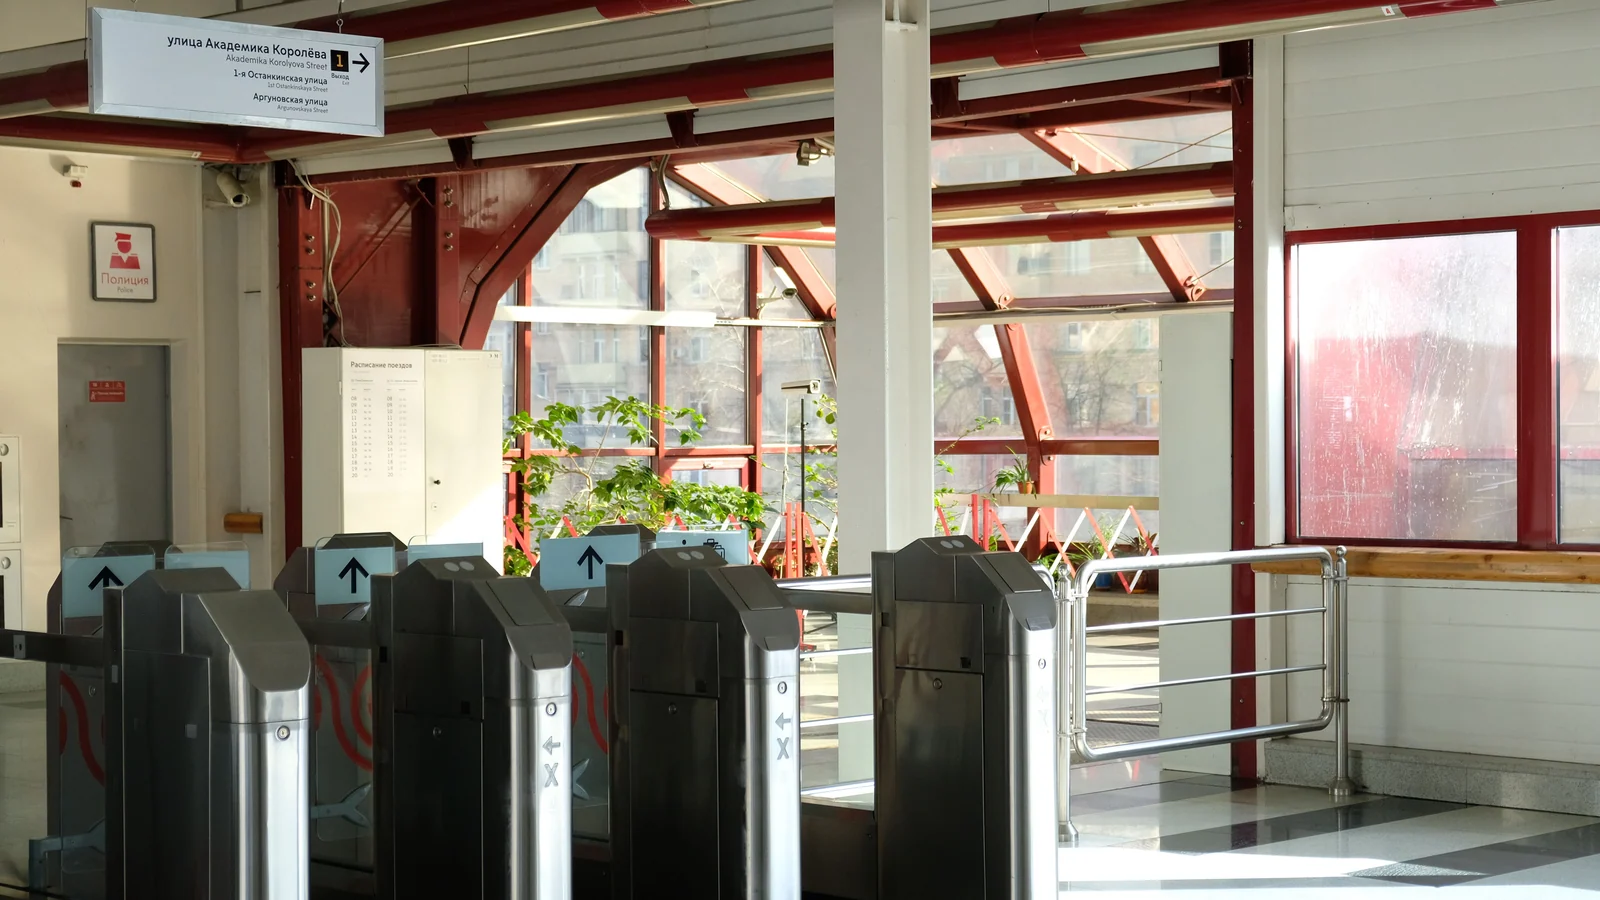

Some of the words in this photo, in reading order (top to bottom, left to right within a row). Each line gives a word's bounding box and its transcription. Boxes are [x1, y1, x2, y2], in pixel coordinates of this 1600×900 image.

[167, 36, 203, 48] улица
[205, 38, 270, 54] Академика
[272, 44, 327, 59] Королёва
[226, 54, 268, 65] Akademika
[269, 58, 305, 69] Korolyova
[306, 61, 328, 71] Street
[336, 54, 344, 68] 1
[233, 69, 246, 78] 1-я
[247, 70, 303, 83] Останкинская
[304, 77, 328, 85] улица
[330, 73, 350, 81] Выход
[275, 82, 313, 93] Ostankinskaya
[253, 92, 304, 104] Аргуновская
[304, 98, 329, 107] улица
[276, 104, 313, 113] Argunovskaya
[101, 272, 149, 286] Полиция
[350, 361, 387, 369] Расписание
